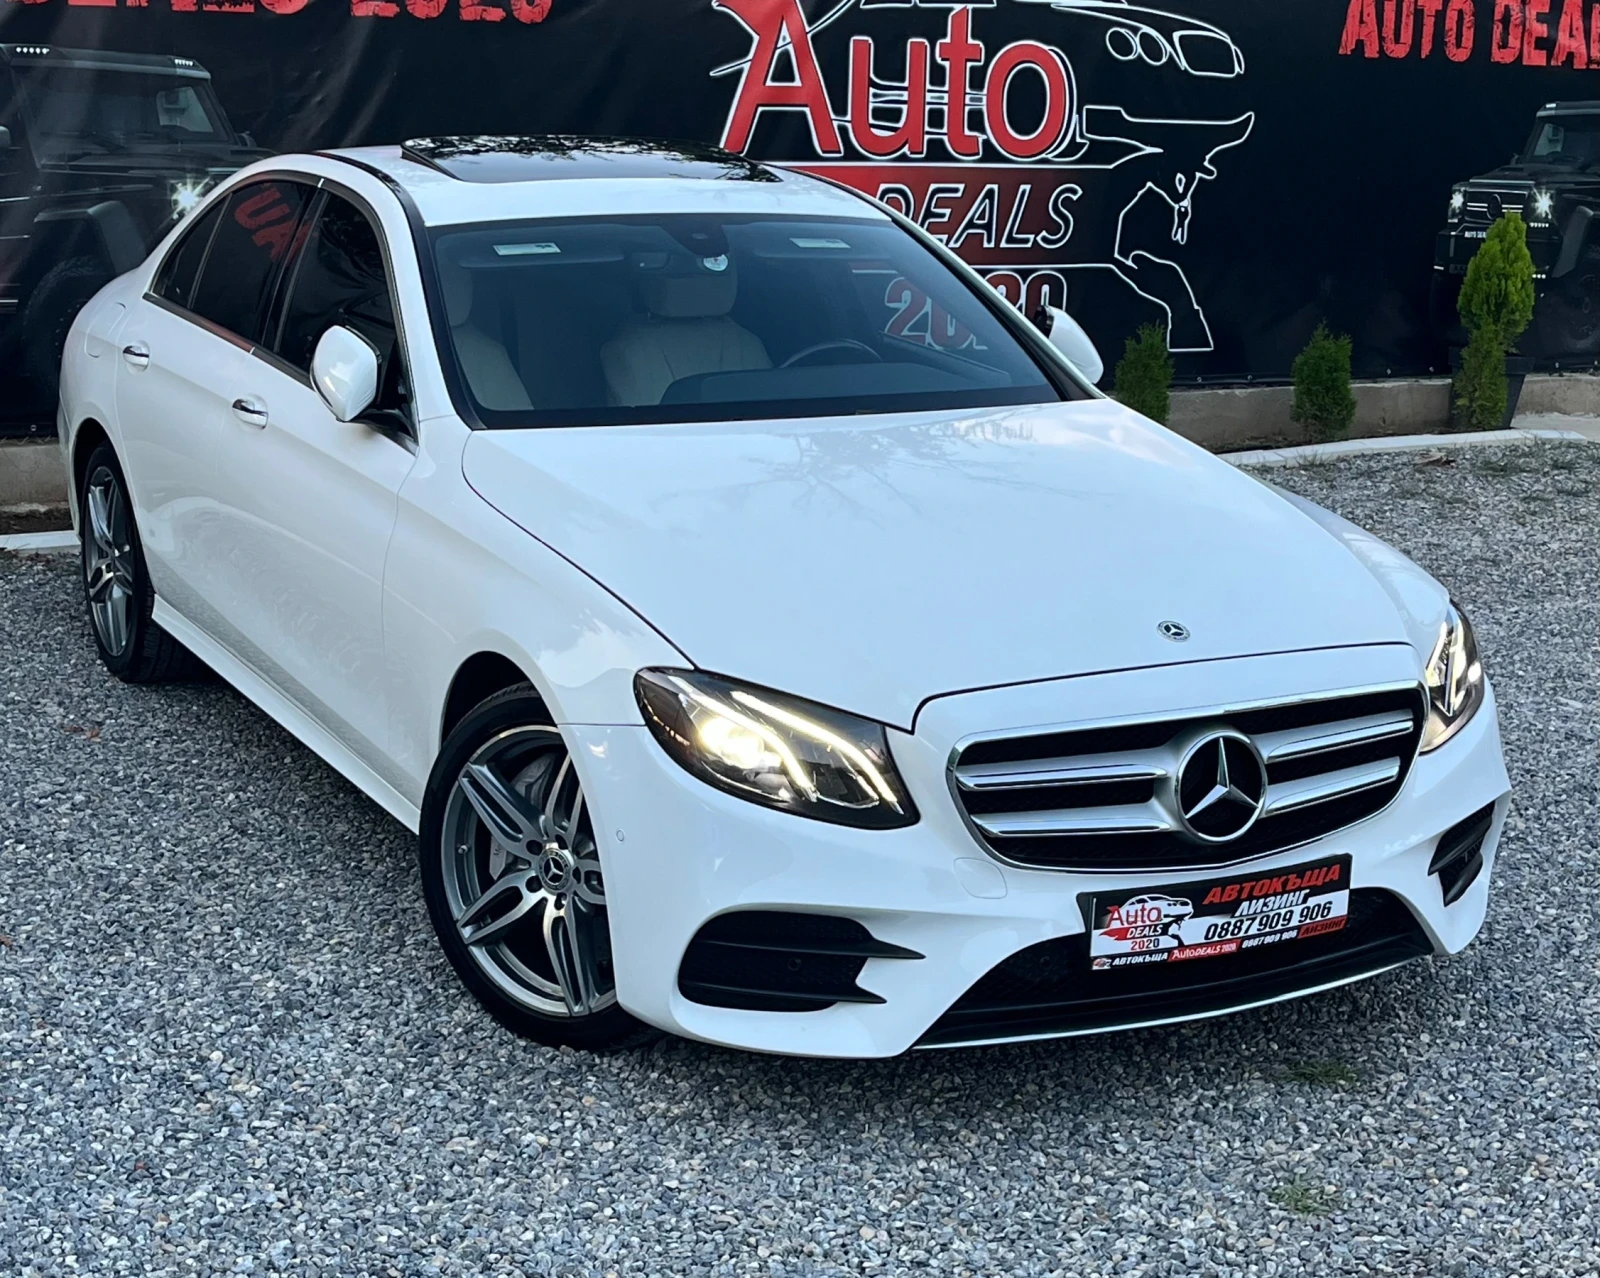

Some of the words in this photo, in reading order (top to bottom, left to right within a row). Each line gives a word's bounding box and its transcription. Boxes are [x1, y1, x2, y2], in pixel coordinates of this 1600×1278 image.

[1338, 0, 1476, 62] AUTO
[712, 0, 1068, 160] Auto
[1203, 864, 1341, 905] АВТОКЪЩА
[1106, 903, 1162, 927] Auto
[1234, 889, 1310, 917] ЛИЗИНГ
[1126, 924, 1163, 939] DEALS
[1204, 917, 1255, 940] 0887
[1256, 909, 1294, 932] 909
[1298, 901, 1333, 923] 906
[1302, 919, 1345, 935] ЛИЗИНГ
[1131, 938, 1160, 951] 2020
[1112, 952, 1168, 966] АВТОКЪЩА
